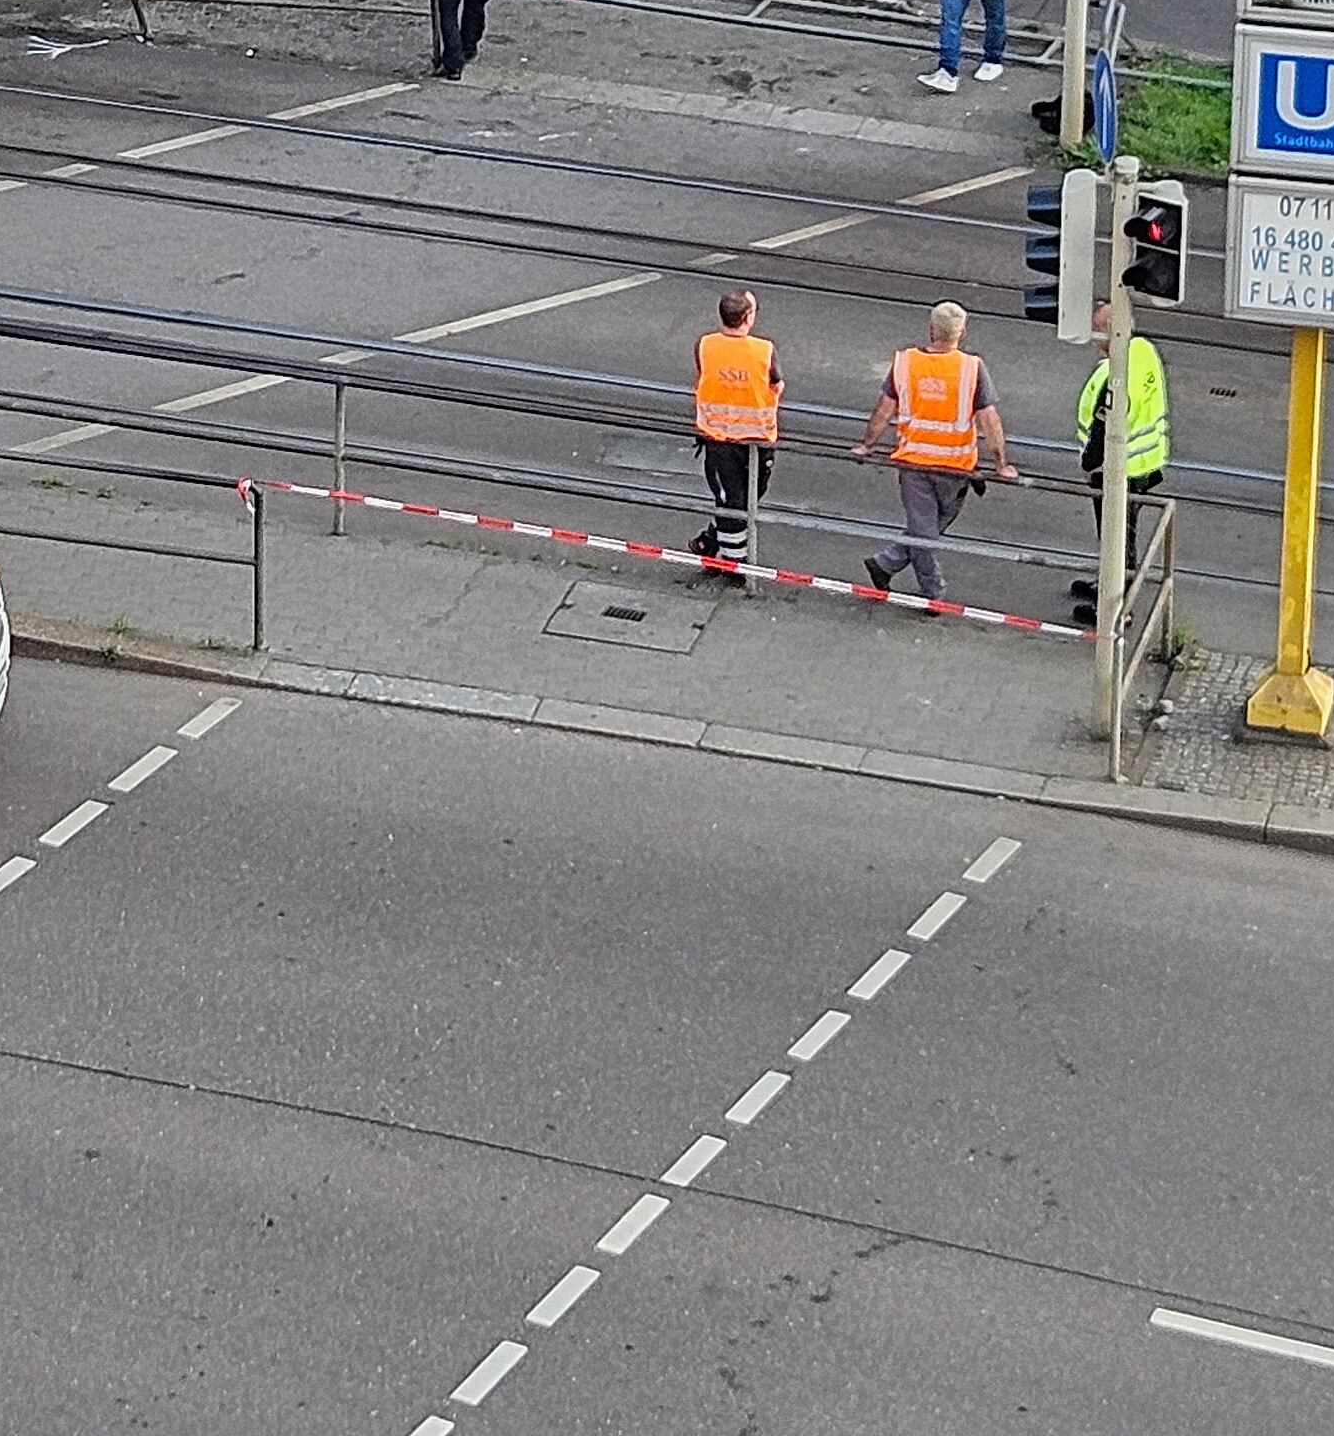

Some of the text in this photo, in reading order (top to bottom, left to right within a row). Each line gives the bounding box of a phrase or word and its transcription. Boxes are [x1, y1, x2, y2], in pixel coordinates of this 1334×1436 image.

[1279, 195, 1333, 221] 0711
[1251, 224, 1277, 248] 16
[1283, 228, 1324, 252] 480
